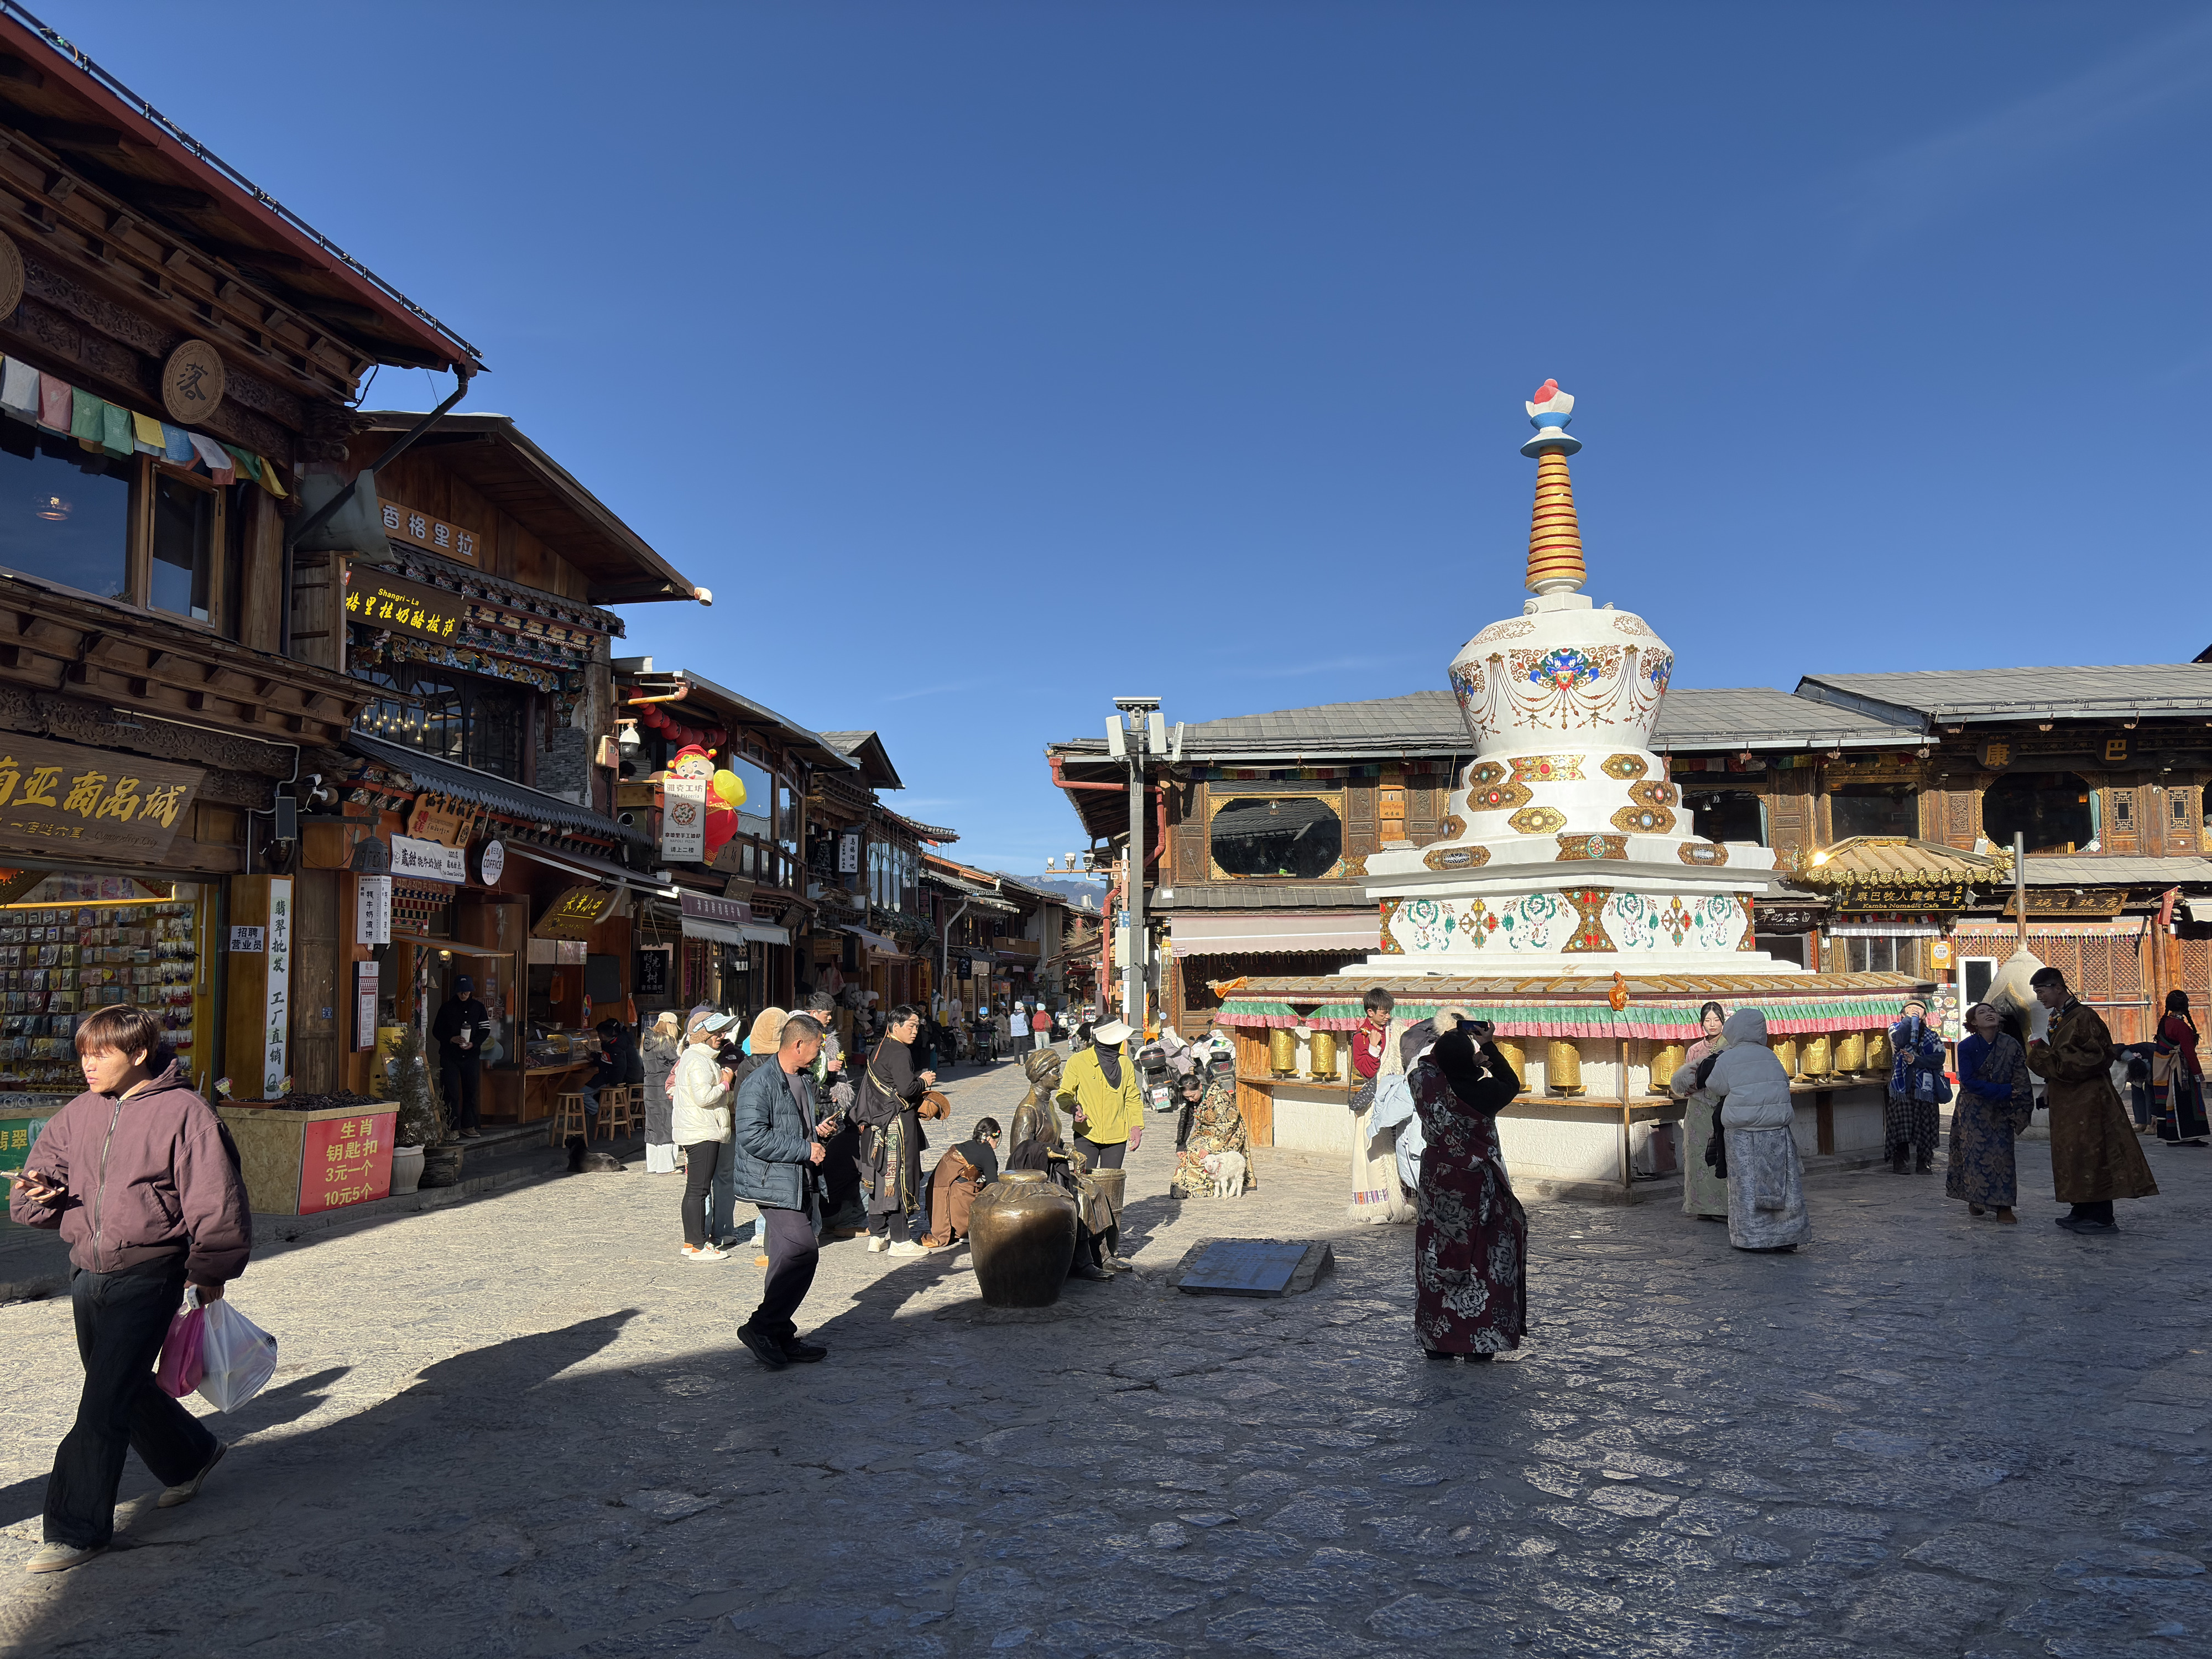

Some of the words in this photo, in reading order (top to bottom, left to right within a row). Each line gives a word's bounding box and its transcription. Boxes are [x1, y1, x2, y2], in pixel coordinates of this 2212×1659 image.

[176, 362, 208, 401] 落
[383, 505, 473, 556] 香格里拉
[1984, 742, 2010, 766] 康
[2105, 739, 2127, 761] 巴
[667, 784, 703, 792] 雅克工坊
[141, 836, 159, 849] City
[483, 858, 502, 870] COFFICE
[1855, 891, 1950, 902] 康巴牧人藏餐吧
[366, 891, 374, 940] 牦牛奶渣饼
[238, 927, 258, 937] 招聘
[272, 899, 287, 973] 翡翠批发
[231, 939, 262, 950] 营业员
[269, 991, 285, 1065] 工厂直销
[340, 1118, 373, 1139] 生肖
[326, 1139, 378, 1162] 钥匙扣
[325, 1159, 373, 1182] 3元一个
[324, 1182, 373, 1206] 10元5个
